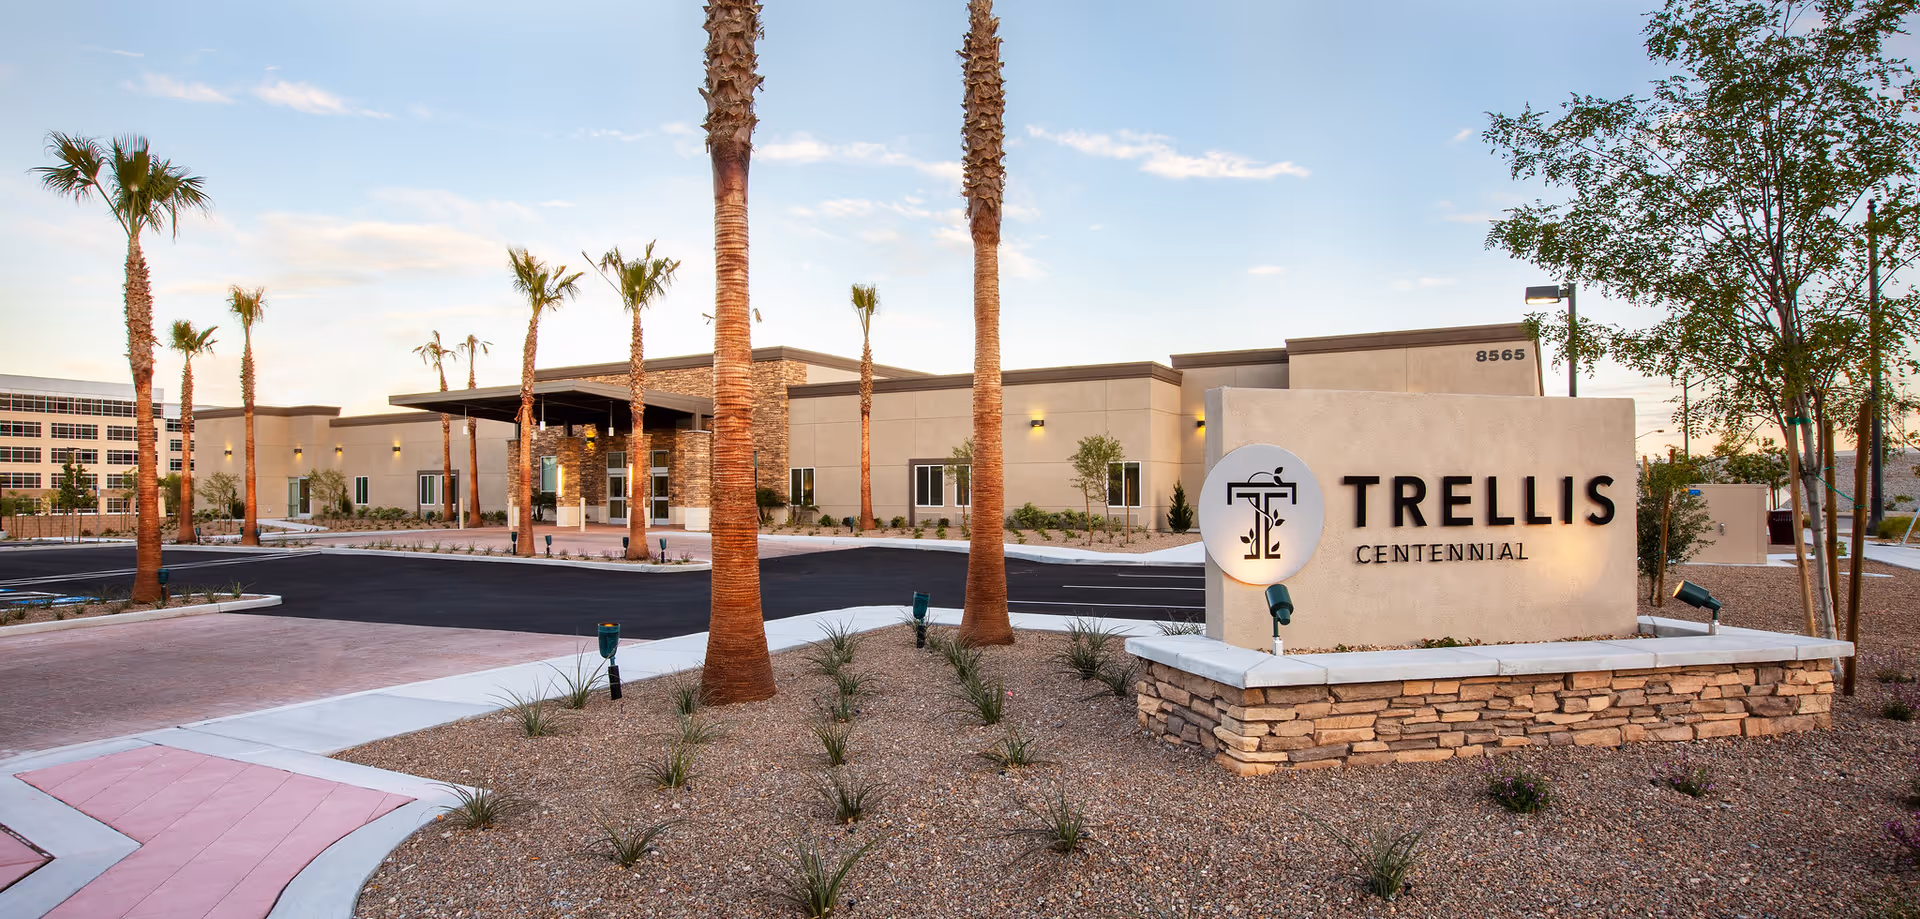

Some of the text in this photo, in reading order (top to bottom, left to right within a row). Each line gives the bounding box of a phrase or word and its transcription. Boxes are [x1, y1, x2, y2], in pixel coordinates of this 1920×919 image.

[1475, 348, 1525, 362] 8565
[1342, 475, 1616, 528] TRELLIS
[1356, 542, 1529, 564] CENTENNIAL
